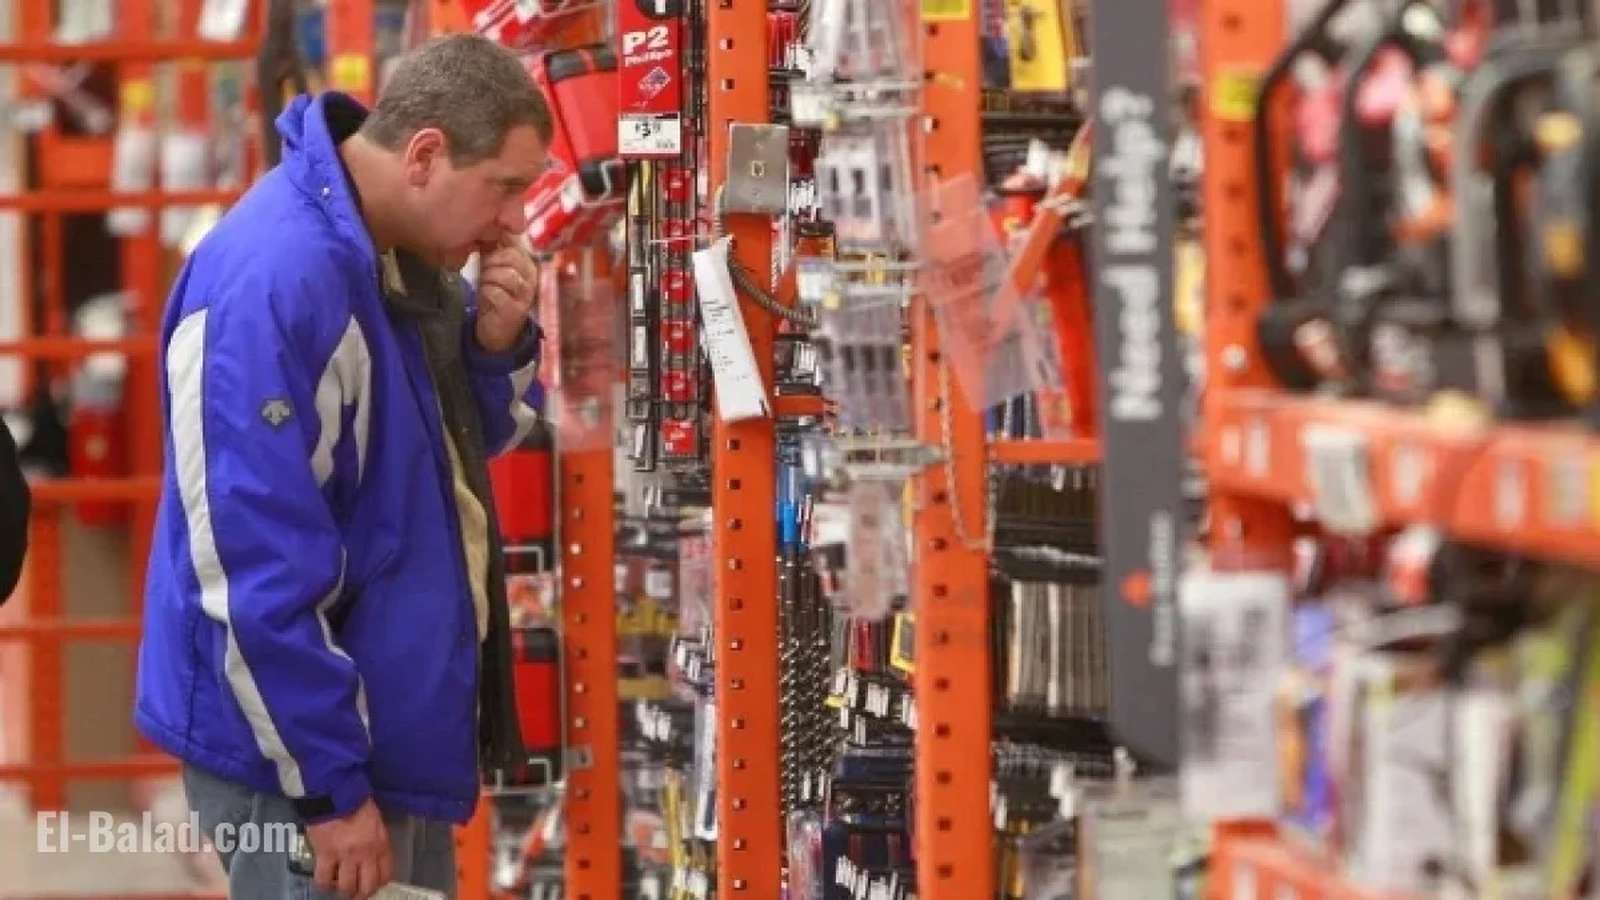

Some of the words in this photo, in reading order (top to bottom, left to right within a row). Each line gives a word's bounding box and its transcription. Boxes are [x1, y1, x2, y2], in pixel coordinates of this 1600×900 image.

[623, 26, 668, 55] P2
[1100, 87, 1165, 251] Help?
[1101, 264, 1163, 421] Need
